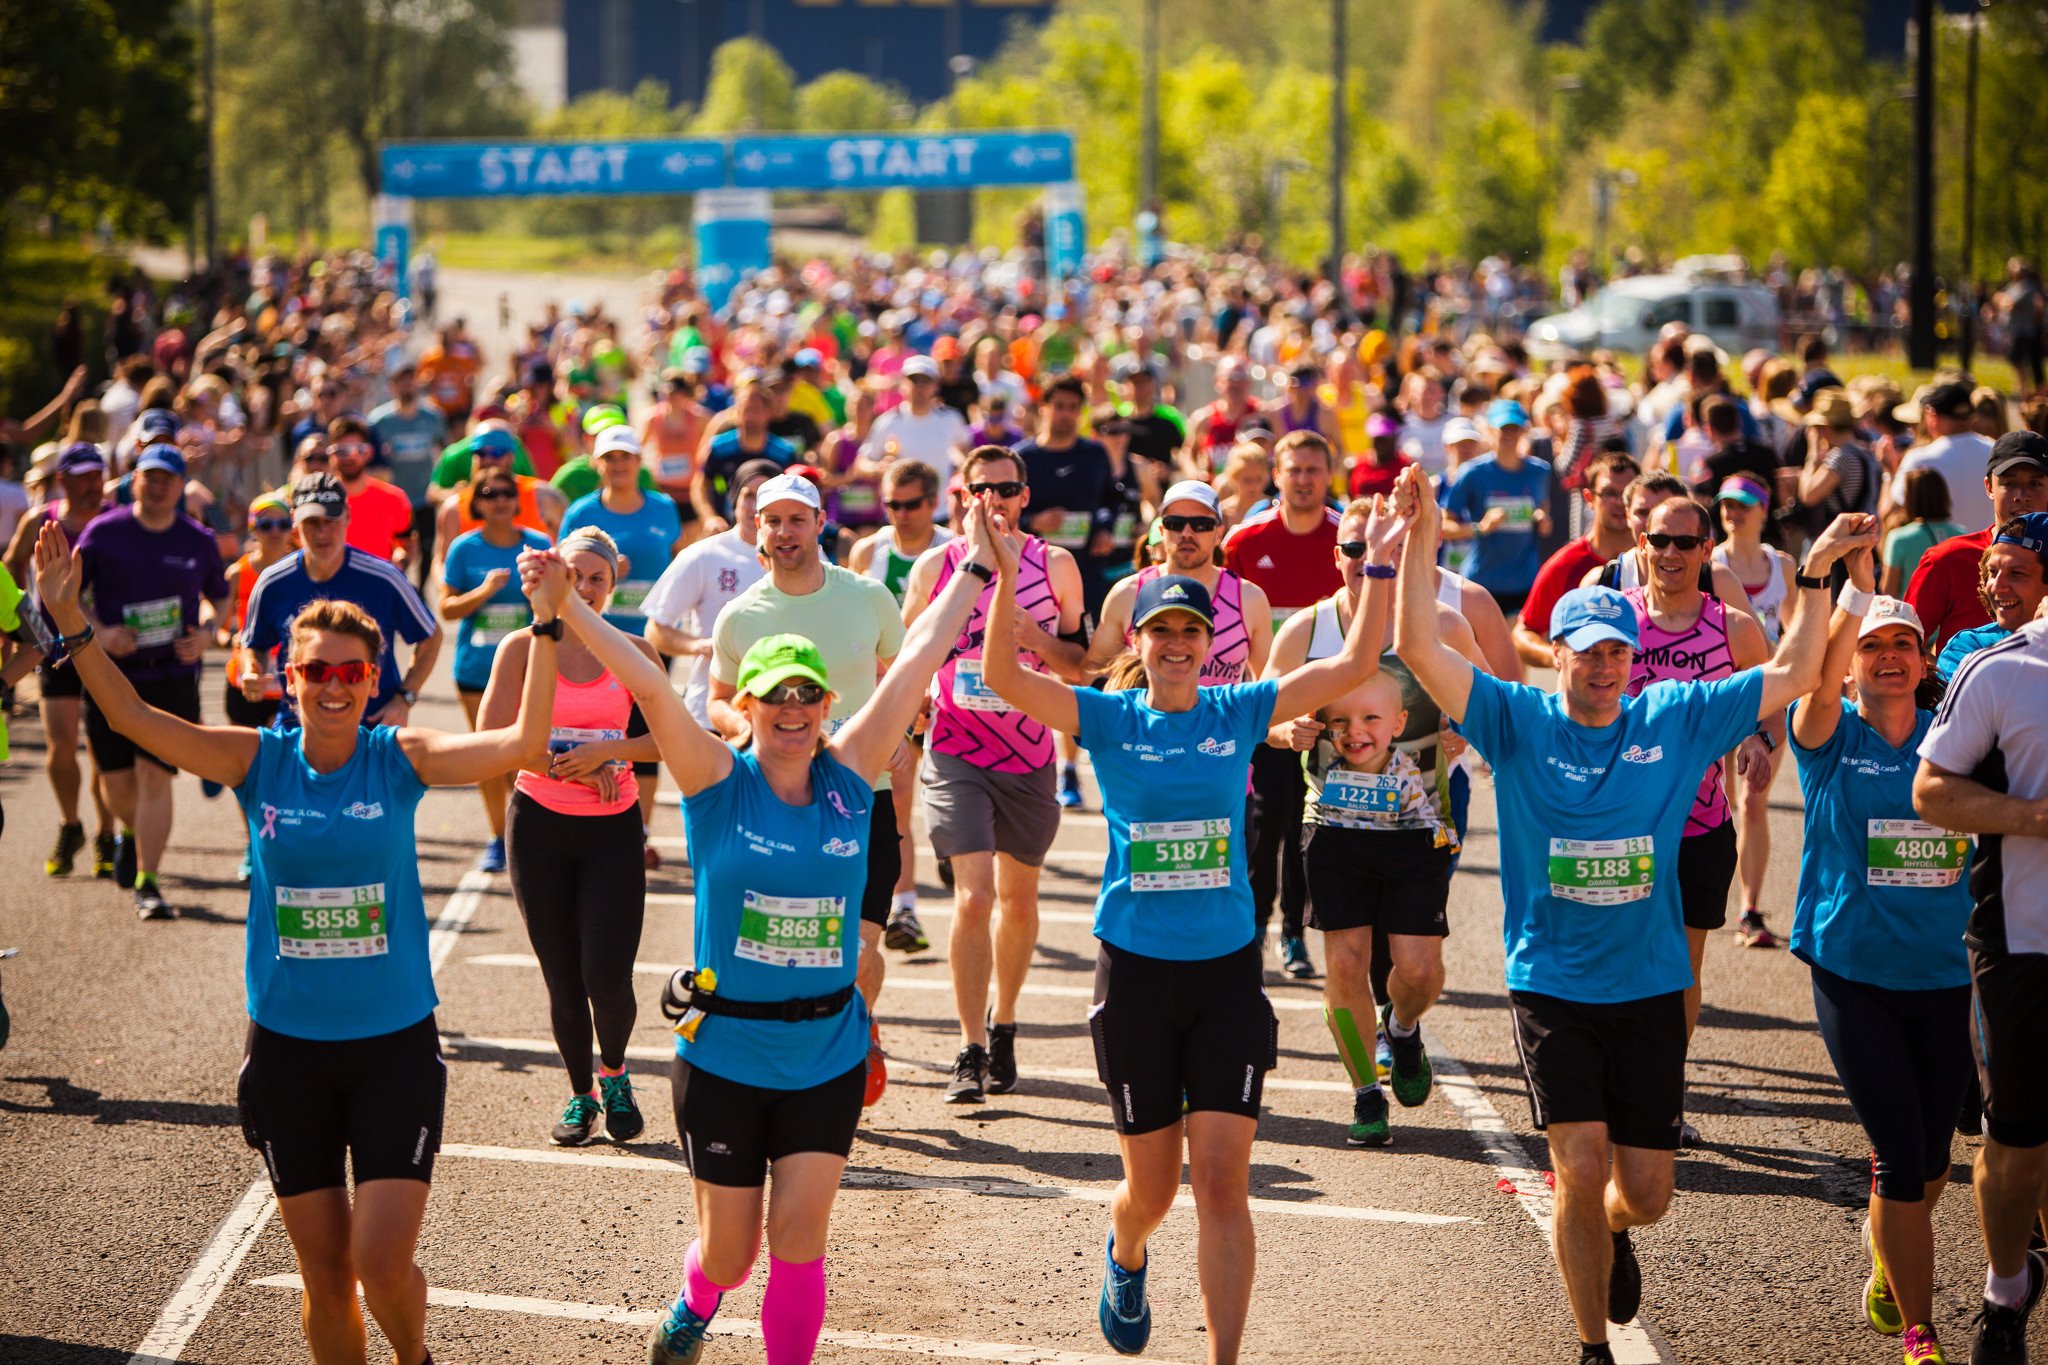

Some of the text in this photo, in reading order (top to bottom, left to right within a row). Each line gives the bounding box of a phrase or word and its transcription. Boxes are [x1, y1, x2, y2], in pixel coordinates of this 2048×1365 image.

[479, 147, 629, 189] START
[827, 139, 979, 180] START
[1199, 659, 1241, 680] olving
[601, 730, 622, 741] 262
[1122, 743, 1133, 752] BE
[1156, 747, 1185, 756] LORIA
[1140, 753, 1164, 762] #BMG
[1547, 756, 1558, 765] BE
[1565, 772, 1587, 783] #BMG
[1857, 766, 1879, 776] #BMG
[1375, 776, 1398, 790] 26.2
[1339, 786, 1379, 805] 1221
[1156, 841, 1209, 862] 5187
[1624, 838, 1650, 856] 13.1
[1894, 840, 1948, 860] 4804
[1576, 859, 1631, 879] 5188
[352, 886, 380, 905] 13.1
[817, 899, 840, 915] 13.1
[302, 909, 360, 930] 5858
[767, 918, 820, 939] 5868
[319, 930, 342, 938] KATIE
